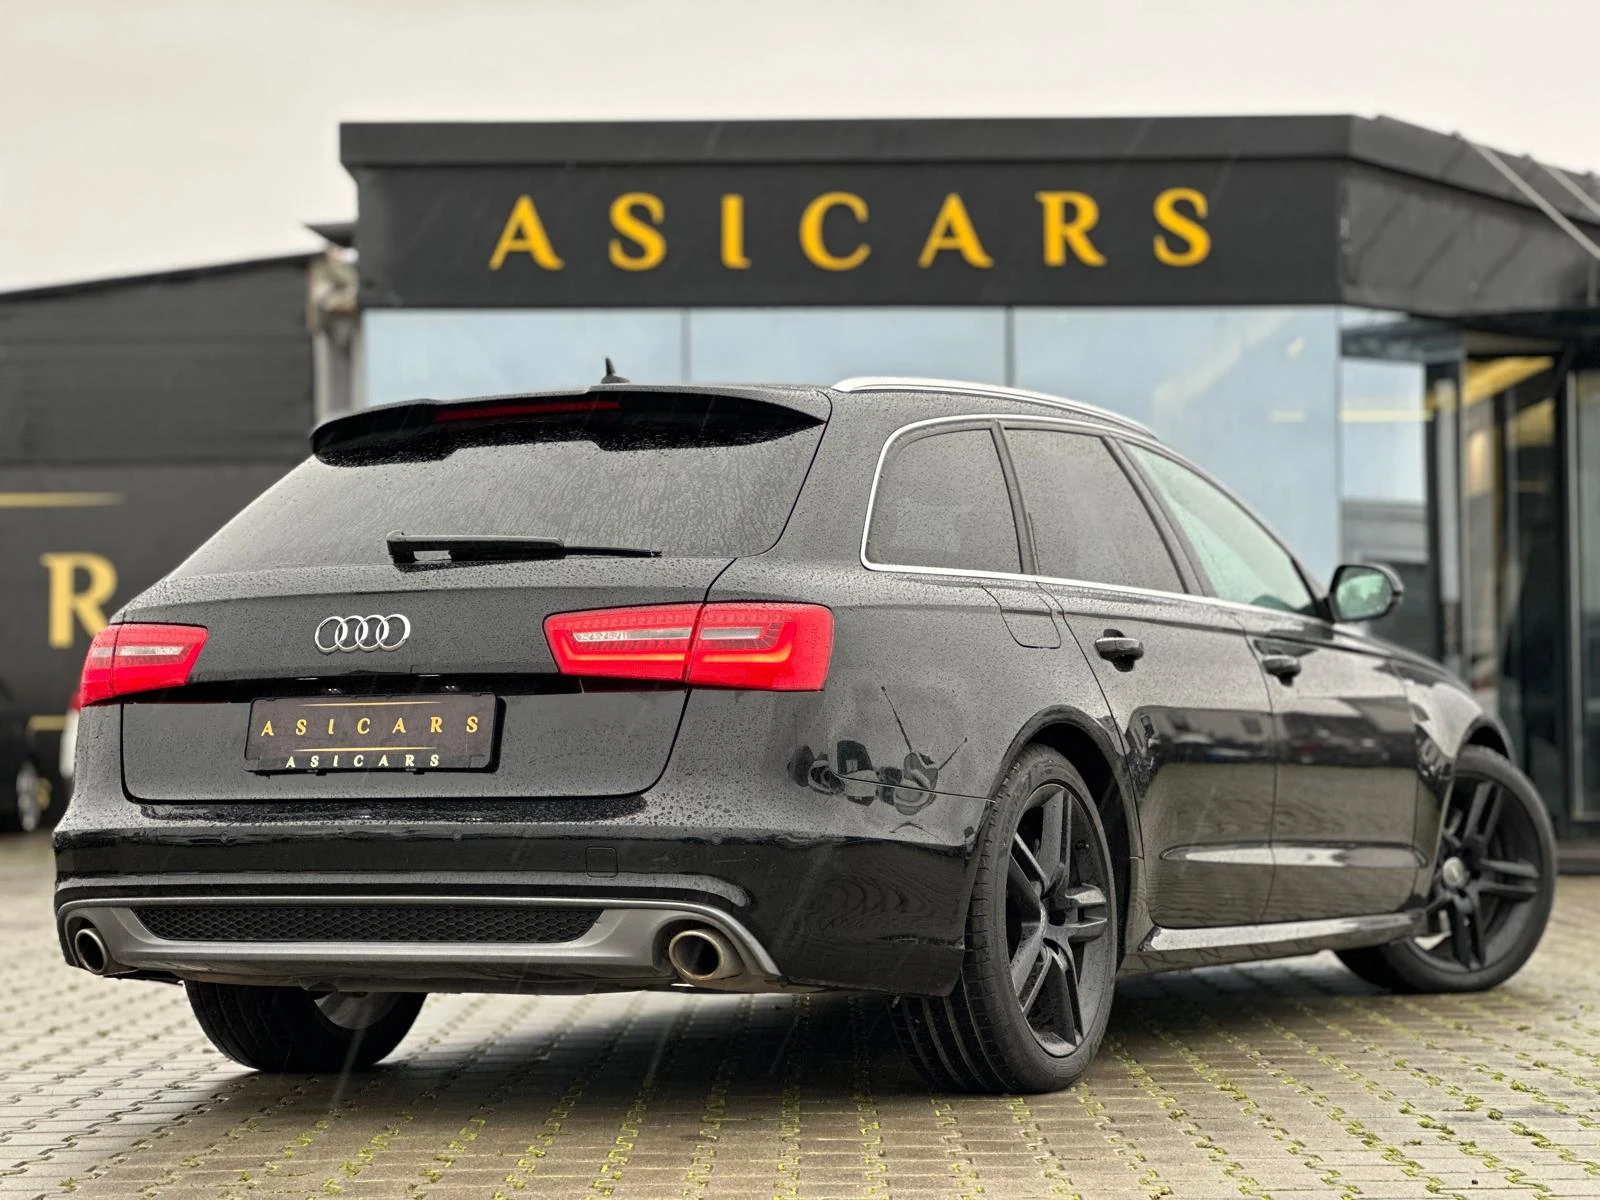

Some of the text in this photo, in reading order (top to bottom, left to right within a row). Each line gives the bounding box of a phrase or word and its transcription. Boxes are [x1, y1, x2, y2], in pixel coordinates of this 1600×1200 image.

[488, 187, 1213, 272] ASICARS
[41, 551, 117, 650] R
[260, 715, 480, 738] ASICARS
[285, 753, 440, 769] ASICARS
